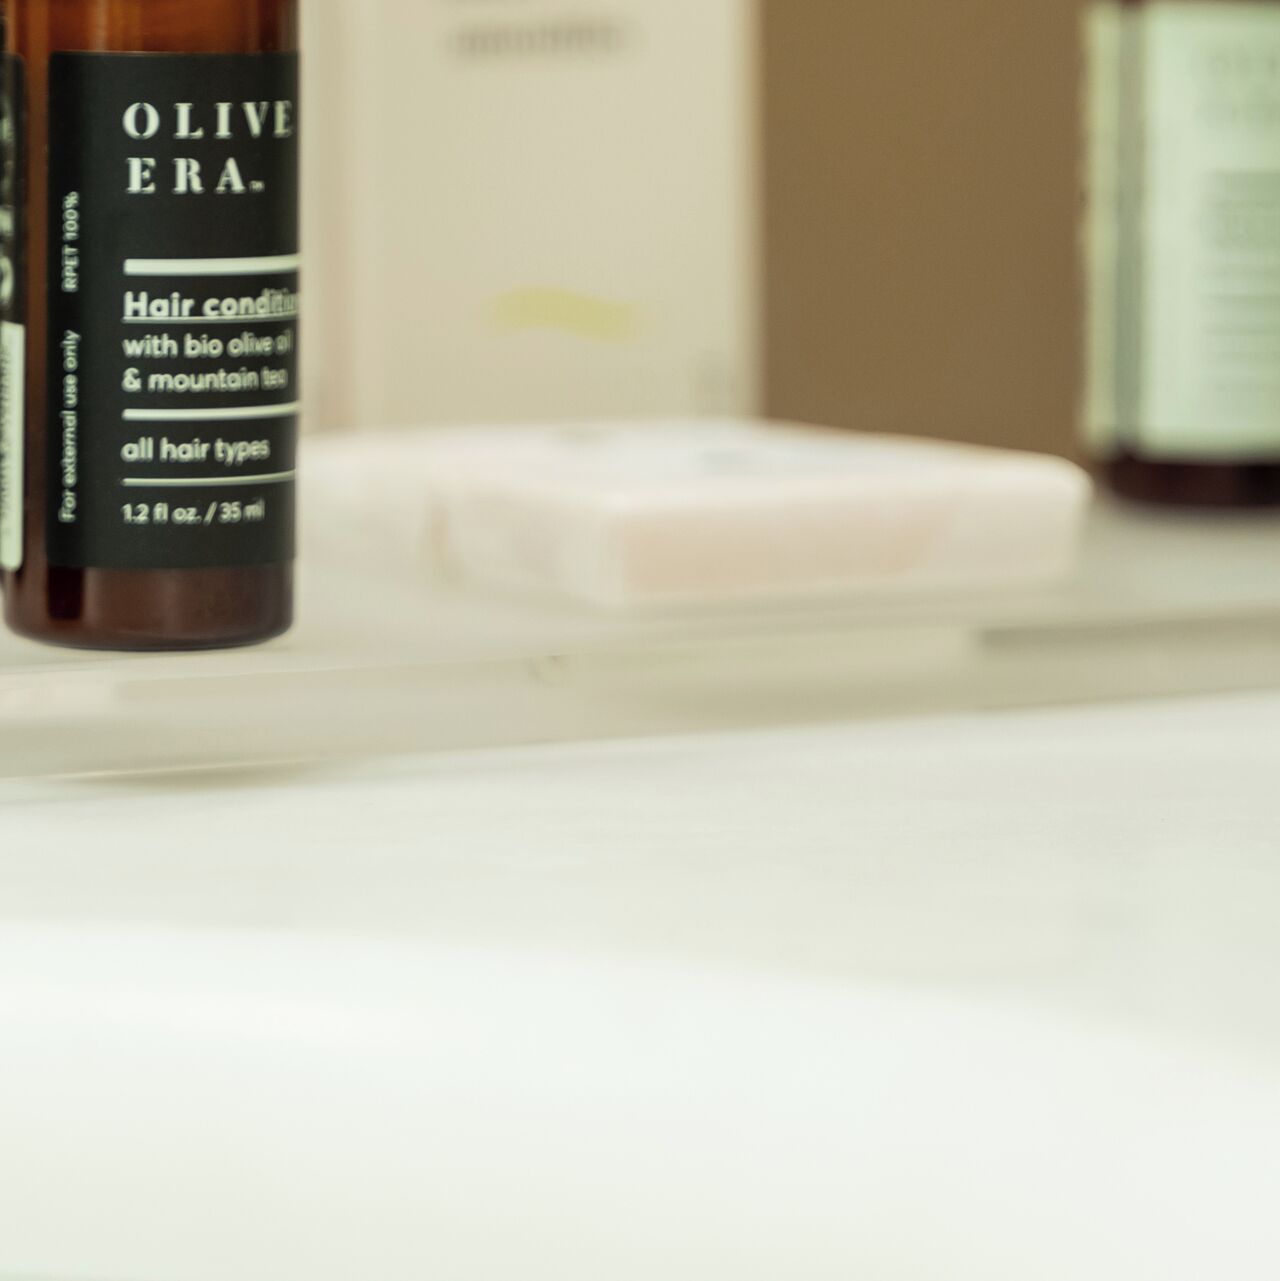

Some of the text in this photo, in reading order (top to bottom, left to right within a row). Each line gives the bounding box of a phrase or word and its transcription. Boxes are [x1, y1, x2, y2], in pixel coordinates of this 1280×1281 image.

[123, 101, 292, 139] OLIVE
[62, 192, 78, 291] RPET 100%
[124, 291, 194, 316] Hair
[123, 333, 178, 357] with
[184, 333, 223, 357] bio
[227, 332, 275, 357] olive
[122, 368, 141, 391] &
[148, 367, 258, 392] mountain
[59, 330, 80, 522] For external use only
[121, 437, 270, 464] all hair types
[123, 504, 149, 523] 1.2
[220, 502, 241, 522] 35
